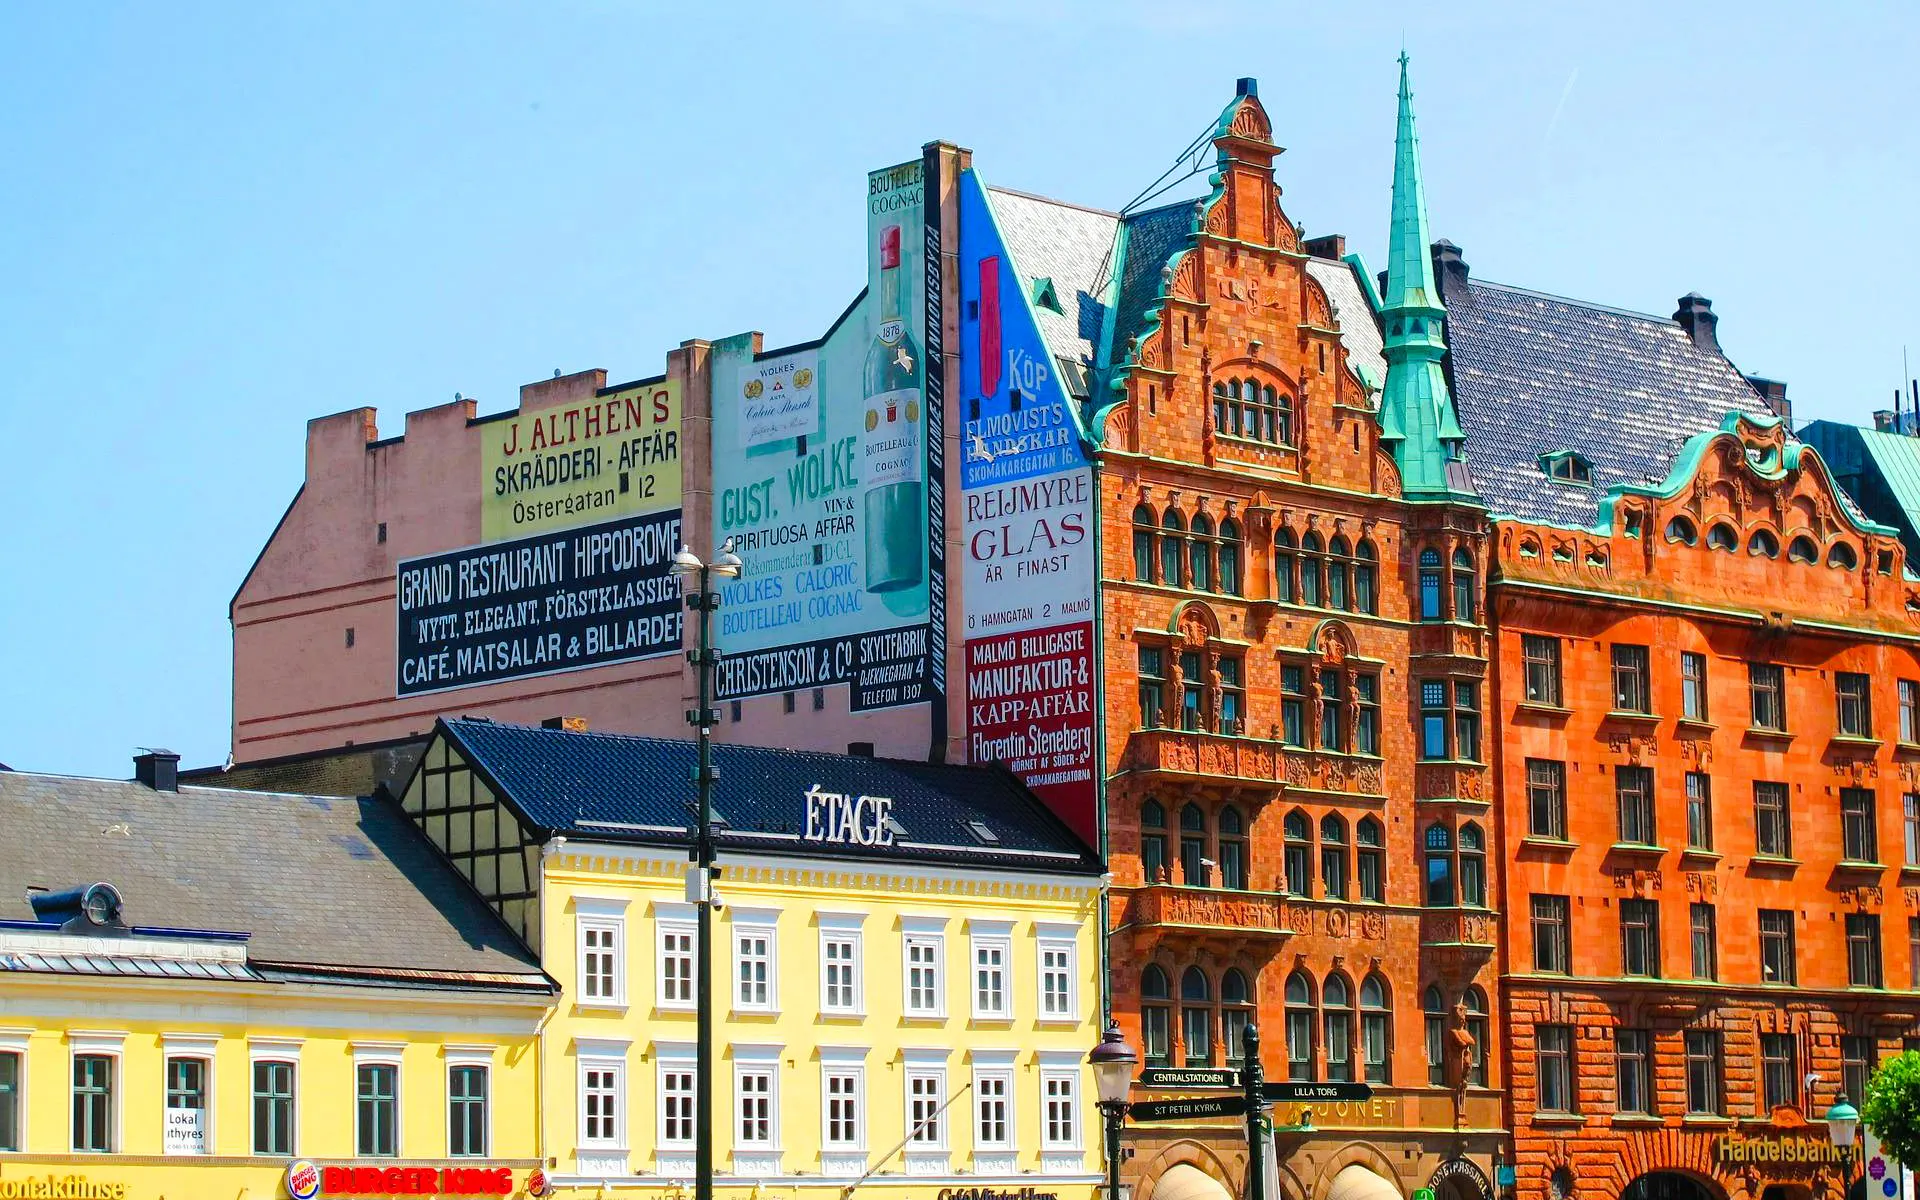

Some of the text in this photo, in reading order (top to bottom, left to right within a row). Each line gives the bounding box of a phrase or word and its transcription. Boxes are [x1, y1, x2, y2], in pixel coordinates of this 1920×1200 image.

[872, 188, 924, 215] COGNAC
[760, 364, 794, 376] WOLKES
[504, 388, 669, 456] J. ALTHÉN'S
[495, 446, 600, 496] SKRÄDDERI
[618, 428, 677, 471] AFFÄR
[969, 452, 1056, 482] SKOMAKAREGATAN
[513, 474, 655, 524] Östergatan 12
[720, 436, 858, 529] GUST. WOLKE
[968, 474, 1088, 522] REIJMYRE
[726, 514, 855, 554] SPIRITUOSA AFFÄR
[930, 475, 943, 561] GENOM
[970, 512, 1085, 561] GLAS
[401, 520, 680, 611] GRAND RESTAURANT HIPPODROME
[986, 554, 1070, 584] ÄR FINAST
[722, 562, 858, 608] WOLKES CALORIC
[418, 574, 682, 644] NYTT, ELEGANT, FÖRSTKLASSIGT
[722, 589, 862, 636] BOUTELLEAU COGNAC
[982, 608, 1033, 628] HAMNGATAN
[1043, 604, 1051, 618] 2
[1062, 598, 1090, 614] MALMÖ
[930, 568, 944, 695] ANNONSERA
[973, 630, 1084, 666] MALMÖ BILLIGASTE
[402, 646, 454, 684] CAFÉ,
[456, 632, 560, 677] MATSALAR
[566, 636, 580, 658] &
[716, 646, 816, 697] CHRISTENSON
[818, 648, 831, 681] &
[860, 628, 928, 665] SKYLTFABRIK
[860, 658, 924, 687] DJEKNEGATAN 4
[861, 684, 922, 706] TELEFON 1307
[972, 690, 1090, 727] KAPP-AFFÄR
[972, 722, 1091, 764] Florentin Steneberg
[1012, 758, 1038, 772] HÖRNET
[1041, 756, 1049, 769] AF
[803, 784, 893, 846] ÉTAGE
[1153, 1073, 1224, 1084] CENTRALSTATIONEN
[1294, 1088, 1338, 1096] LILLA TORG
[169, 1113, 198, 1124] Lokal
[1170, 1104, 1191, 1114] PETRI
[1194, 1103, 1222, 1113] KYRKA
[1719, 1135, 1860, 1162] Handelsbankn
[294, 1172, 317, 1194] KING
[322, 1166, 513, 1195] BURGER KING
